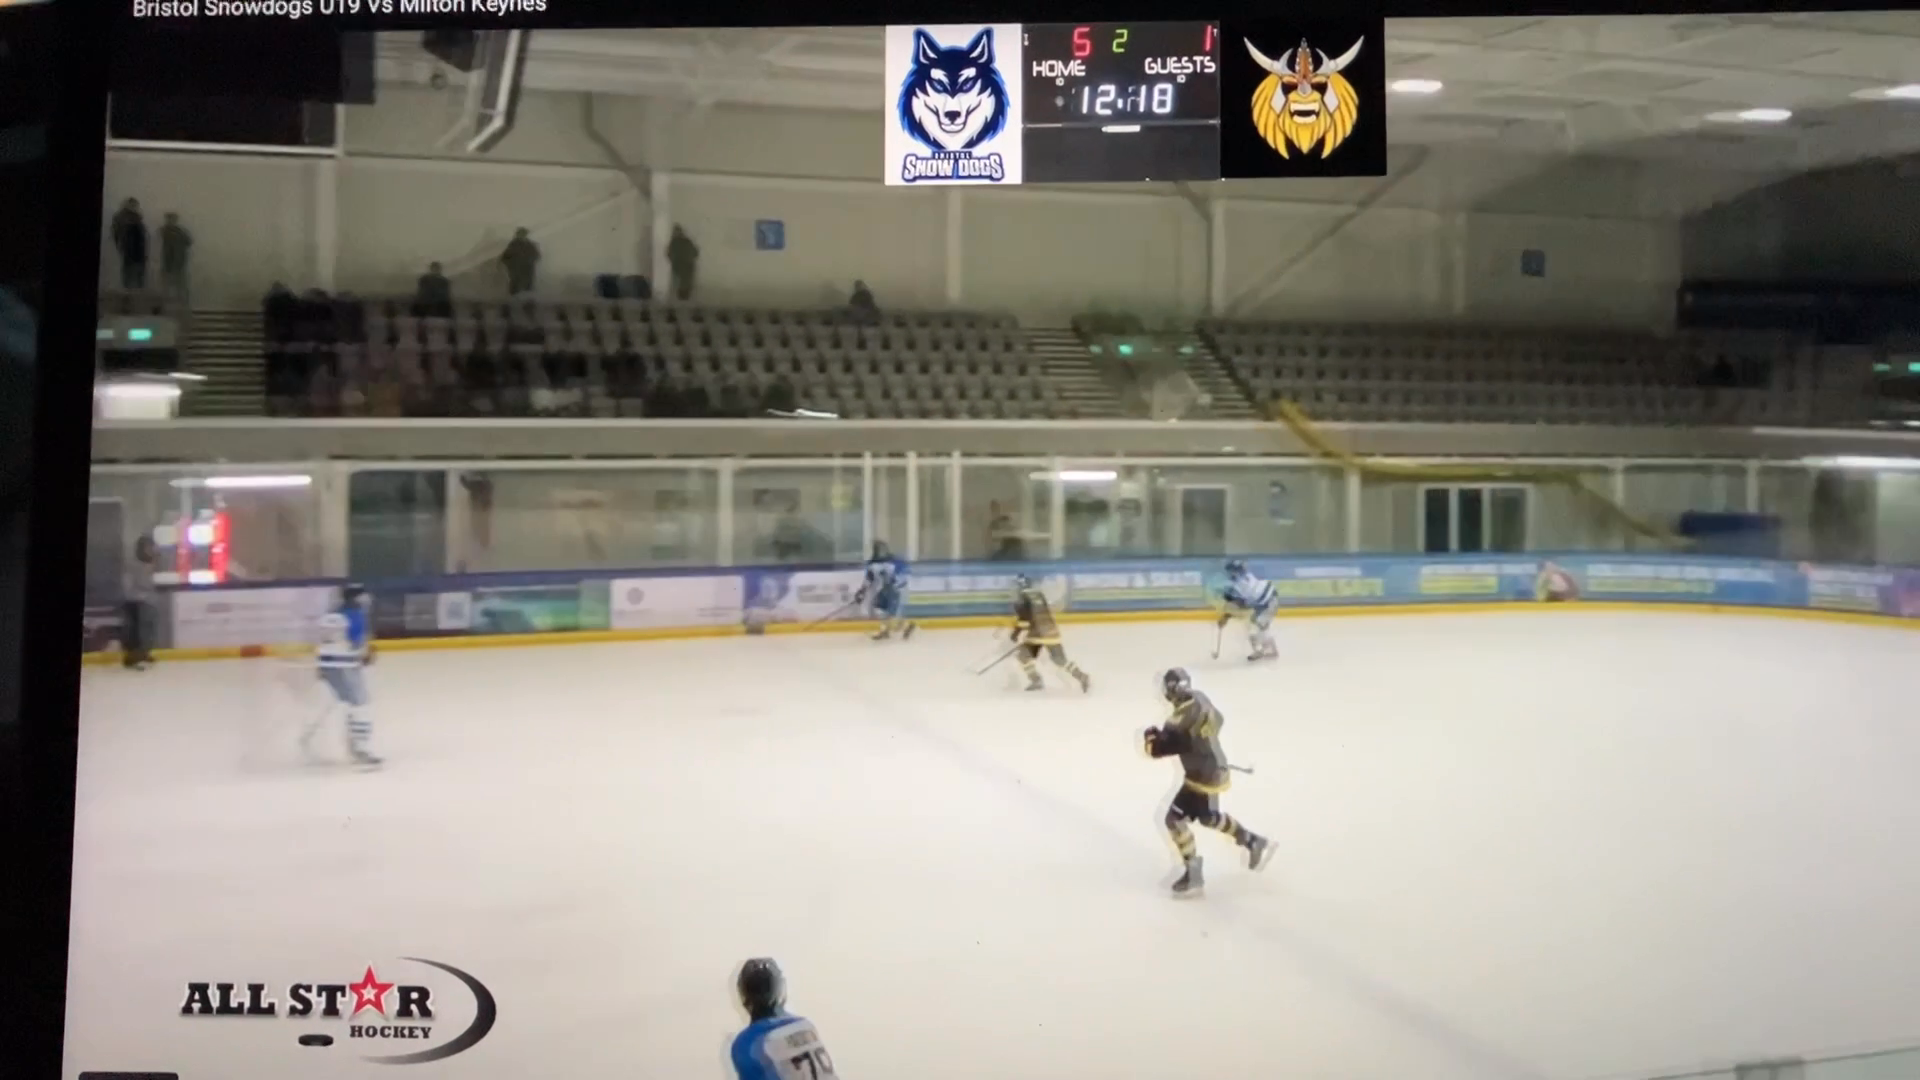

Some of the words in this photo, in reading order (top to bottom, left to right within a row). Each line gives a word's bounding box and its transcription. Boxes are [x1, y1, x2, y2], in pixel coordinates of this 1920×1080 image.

[133, 0, 197, 17] Bristol
[204, 0, 313, 19] Snowdogs
[319, 0, 360, 14] U19
[400, 0, 465, 13] Milton
[472, 0, 547, 15] Keynes
[1073, 27, 1091, 57] 5
[1112, 29, 1128, 52] 2
[1205, 25, 1212, 51] 1
[1033, 60, 1086, 77] HOME
[1144, 56, 1216, 75] GUESTS
[903, 154, 954, 180] SNOW
[957, 153, 1003, 180] DOGS
[182, 982, 276, 1015] ALL
[350, 1025, 432, 1039] HOCKEY
